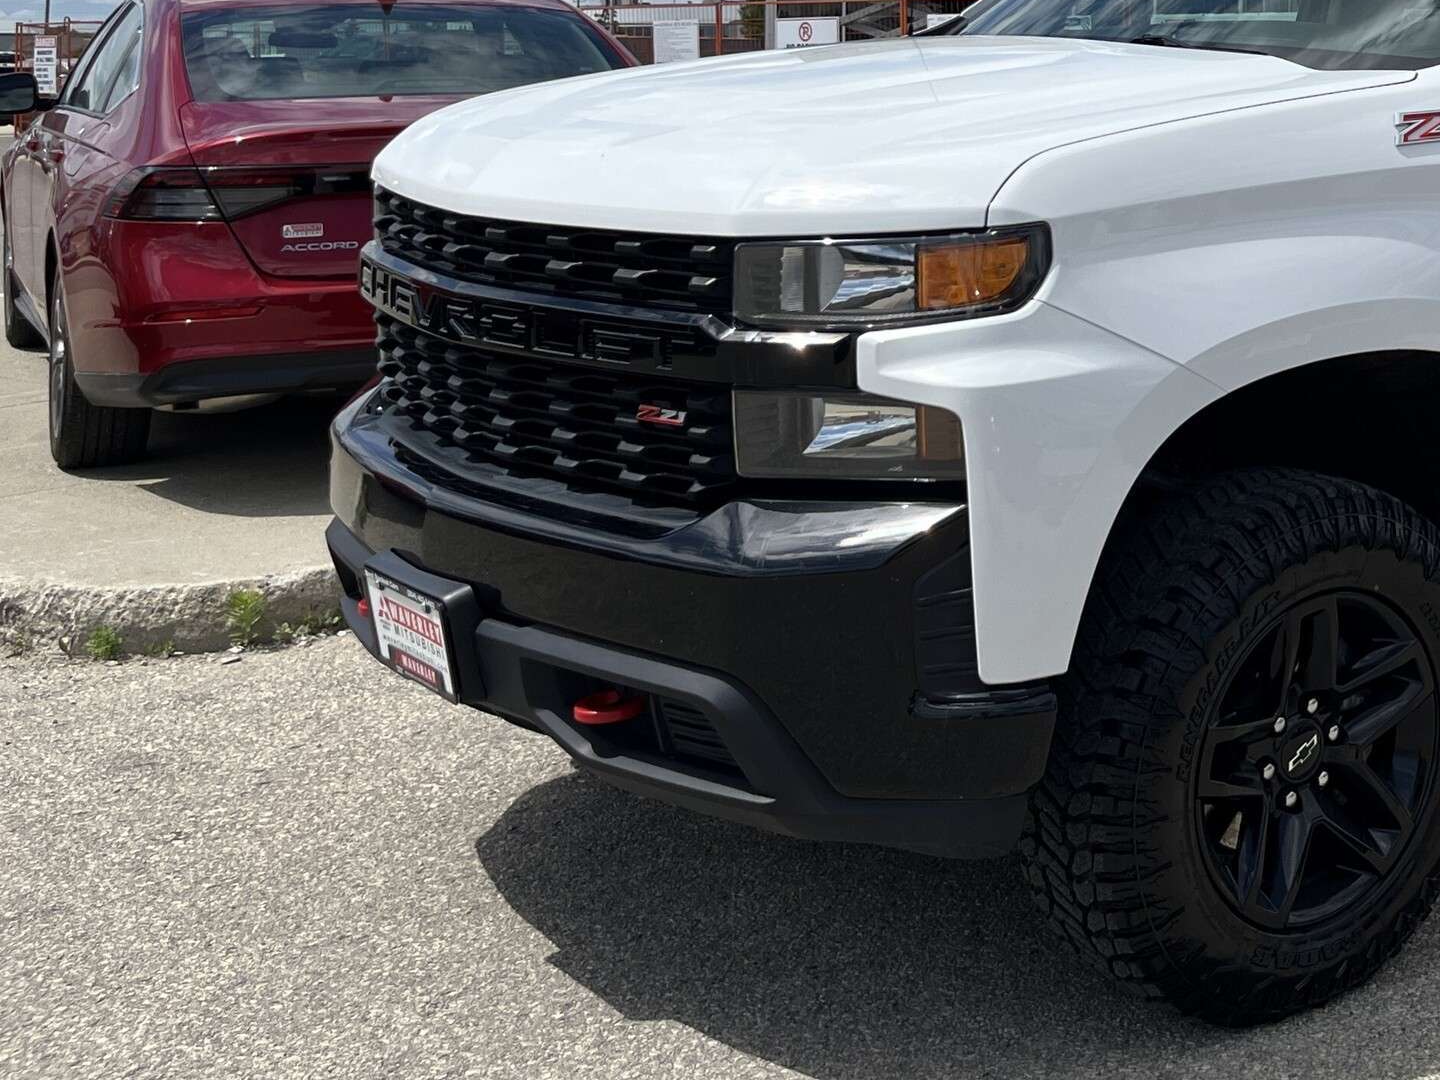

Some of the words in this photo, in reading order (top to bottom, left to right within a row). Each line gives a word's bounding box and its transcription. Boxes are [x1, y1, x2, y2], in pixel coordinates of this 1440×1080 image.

[281, 241, 359, 252] ACCORD
[359, 258, 696, 371] CHEVROLET
[390, 601, 442, 646] WAVERLEY
